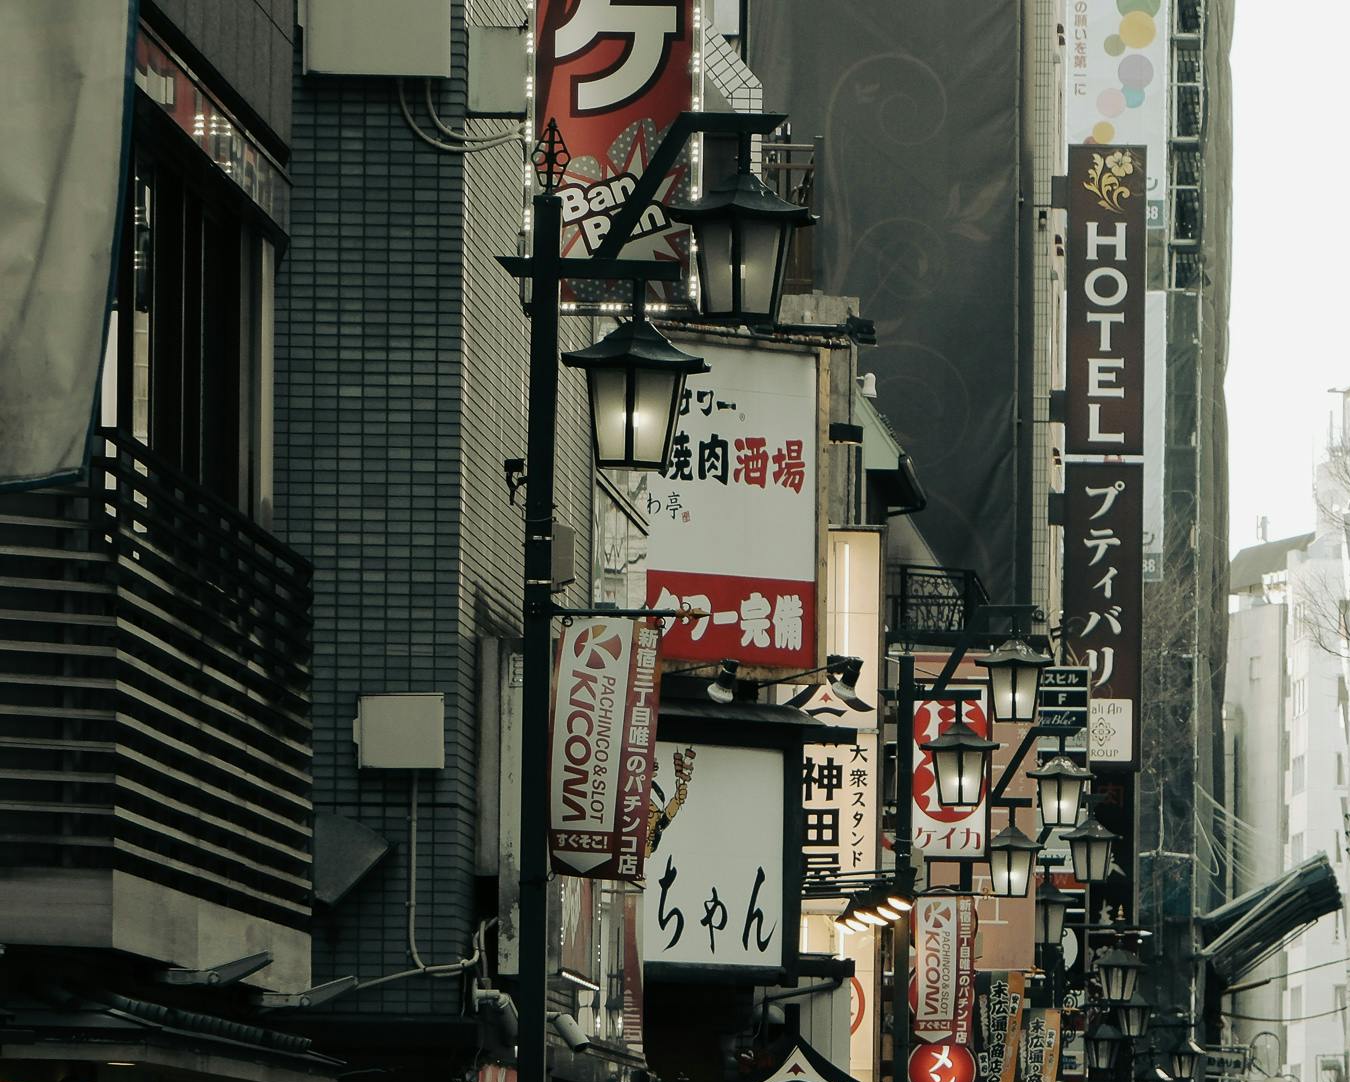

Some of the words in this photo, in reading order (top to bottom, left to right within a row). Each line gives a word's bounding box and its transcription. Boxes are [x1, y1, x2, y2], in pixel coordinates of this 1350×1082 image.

[553, 176, 638, 223] Ban
[582, 204, 668, 251] Bn
[1084, 221, 1129, 443] HOTEL
[657, 430, 806, 494] 焼肉酒場
[1080, 480, 1126, 687] プティバリ
[1040, 673, 1080, 685] スビル
[1058, 692, 1068, 705] F
[561, 669, 598, 823] KICONA
[594, 675, 616, 763] PACHINCO
[617, 627, 659, 876] 新宿三丁目唯一のパチンコ店
[1091, 748, 1119, 757] ROUP
[589, 778, 606, 824] SLOT
[849, 744, 869, 868] 大衆スタンド
[915, 827, 981, 850] ケイカ
[658, 854, 777, 954] ちゃん
[924, 930, 940, 1016] KICONA
